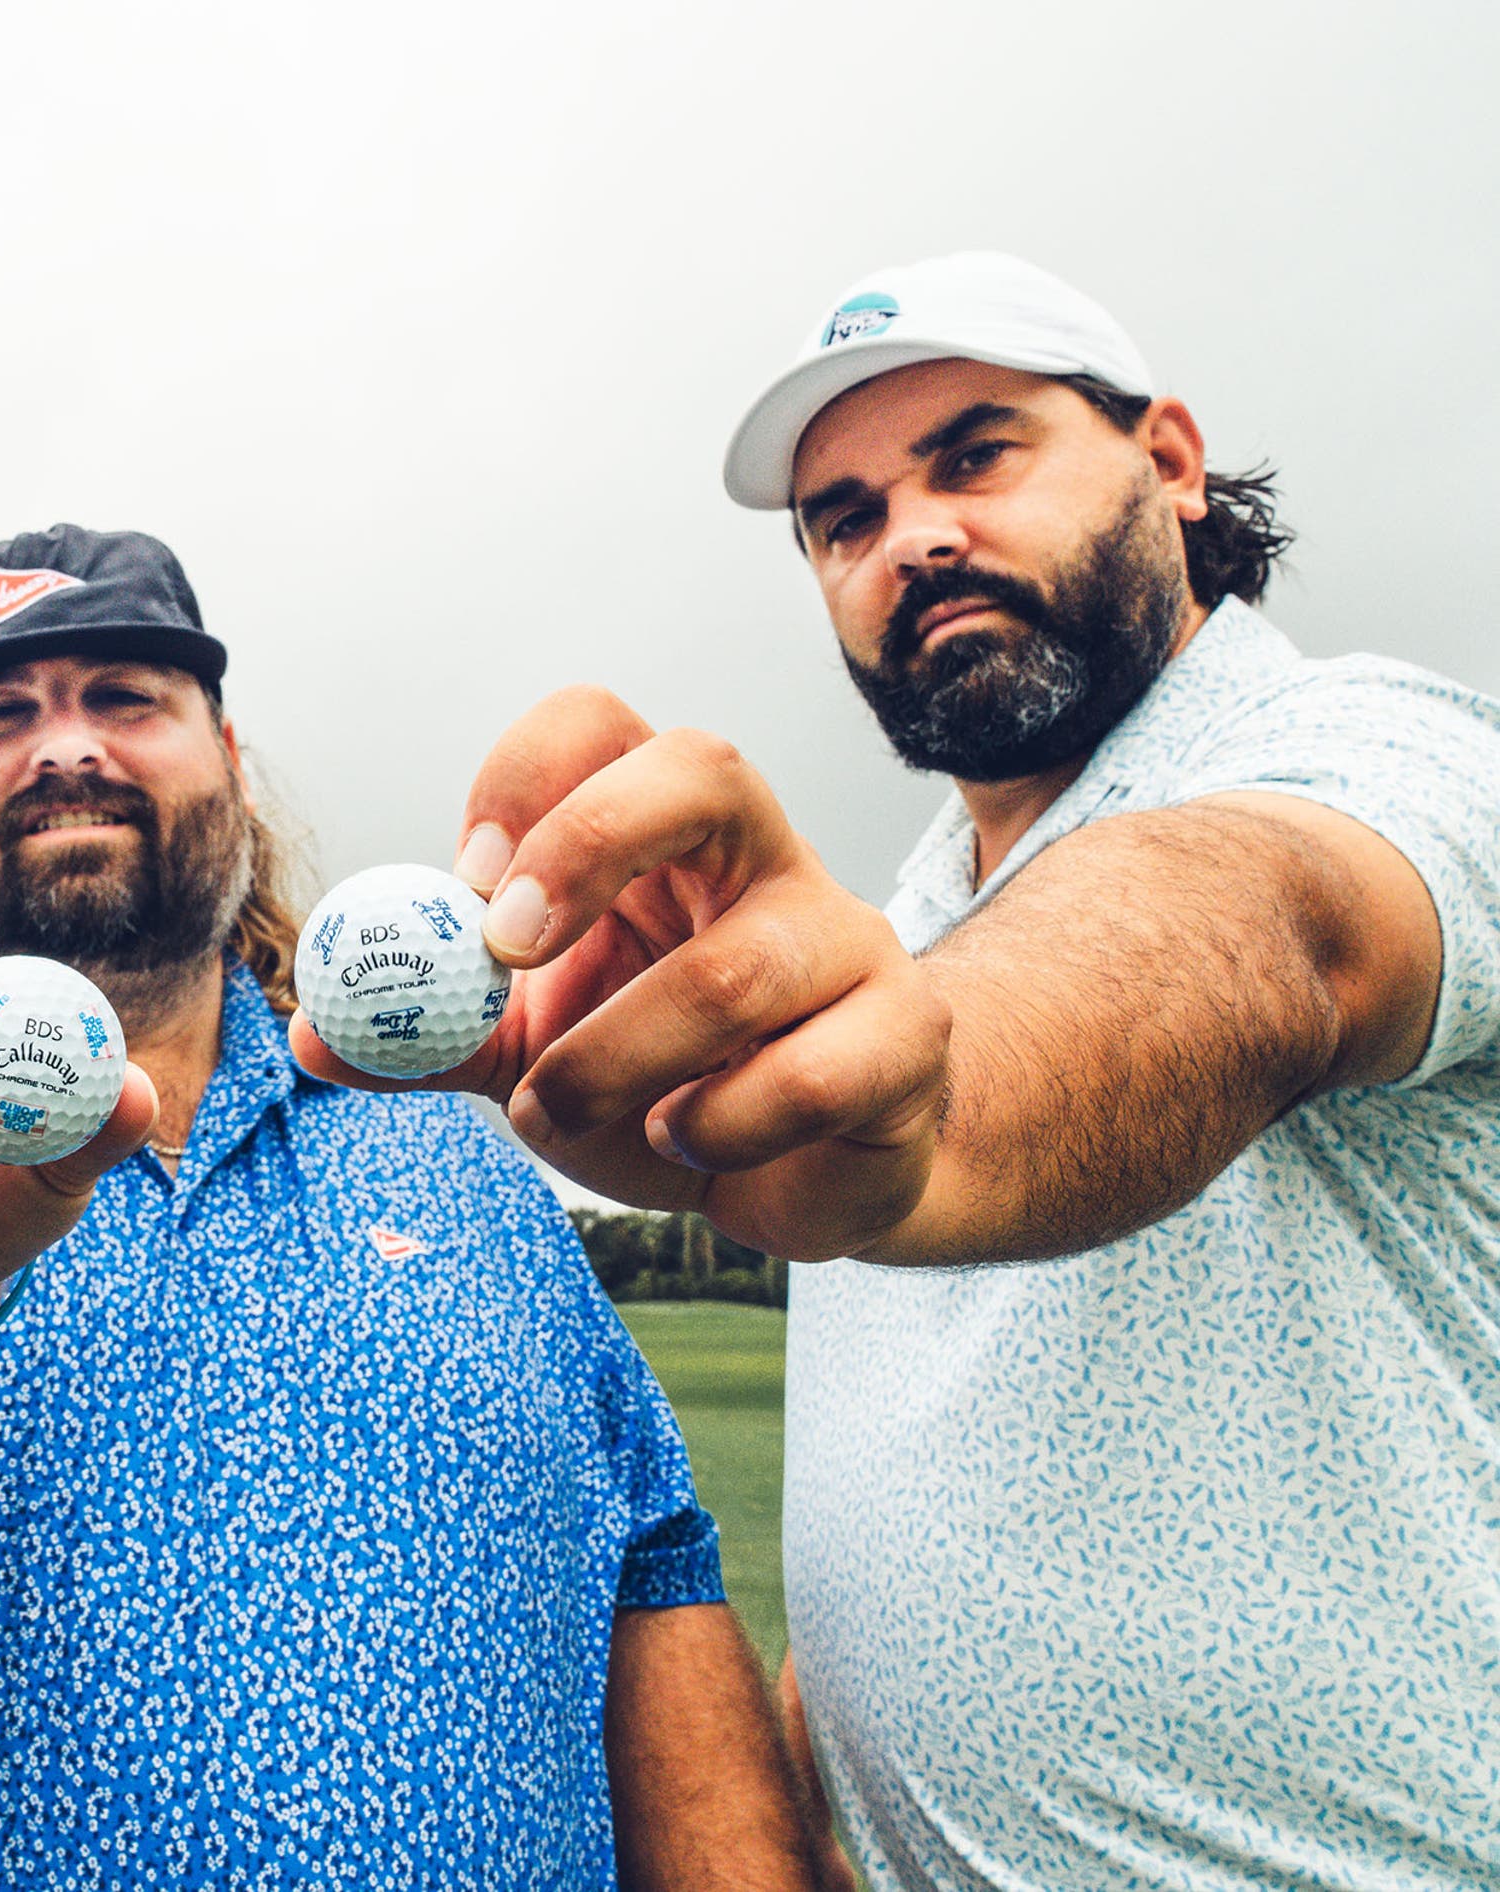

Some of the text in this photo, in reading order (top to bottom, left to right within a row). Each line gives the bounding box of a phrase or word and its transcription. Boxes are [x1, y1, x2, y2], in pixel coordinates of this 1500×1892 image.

[418, 902, 454, 942] A Day
[432, 897, 463, 932] Have
[311, 913, 333, 951] Have
[327, 912, 345, 943] Day
[360, 923, 401, 946] BDS
[341, 951, 434, 988] Callaway
[353, 980, 428, 998] CHROME TOUR
[25, 1018, 63, 1041] BDS
[370, 1013, 402, 1029] Day
[377, 1025, 420, 1040] Have
[41, 1082, 68, 1095] TOUR
[2, 1111, 36, 1126] DOES
[3, 1120, 30, 1134] BOB
